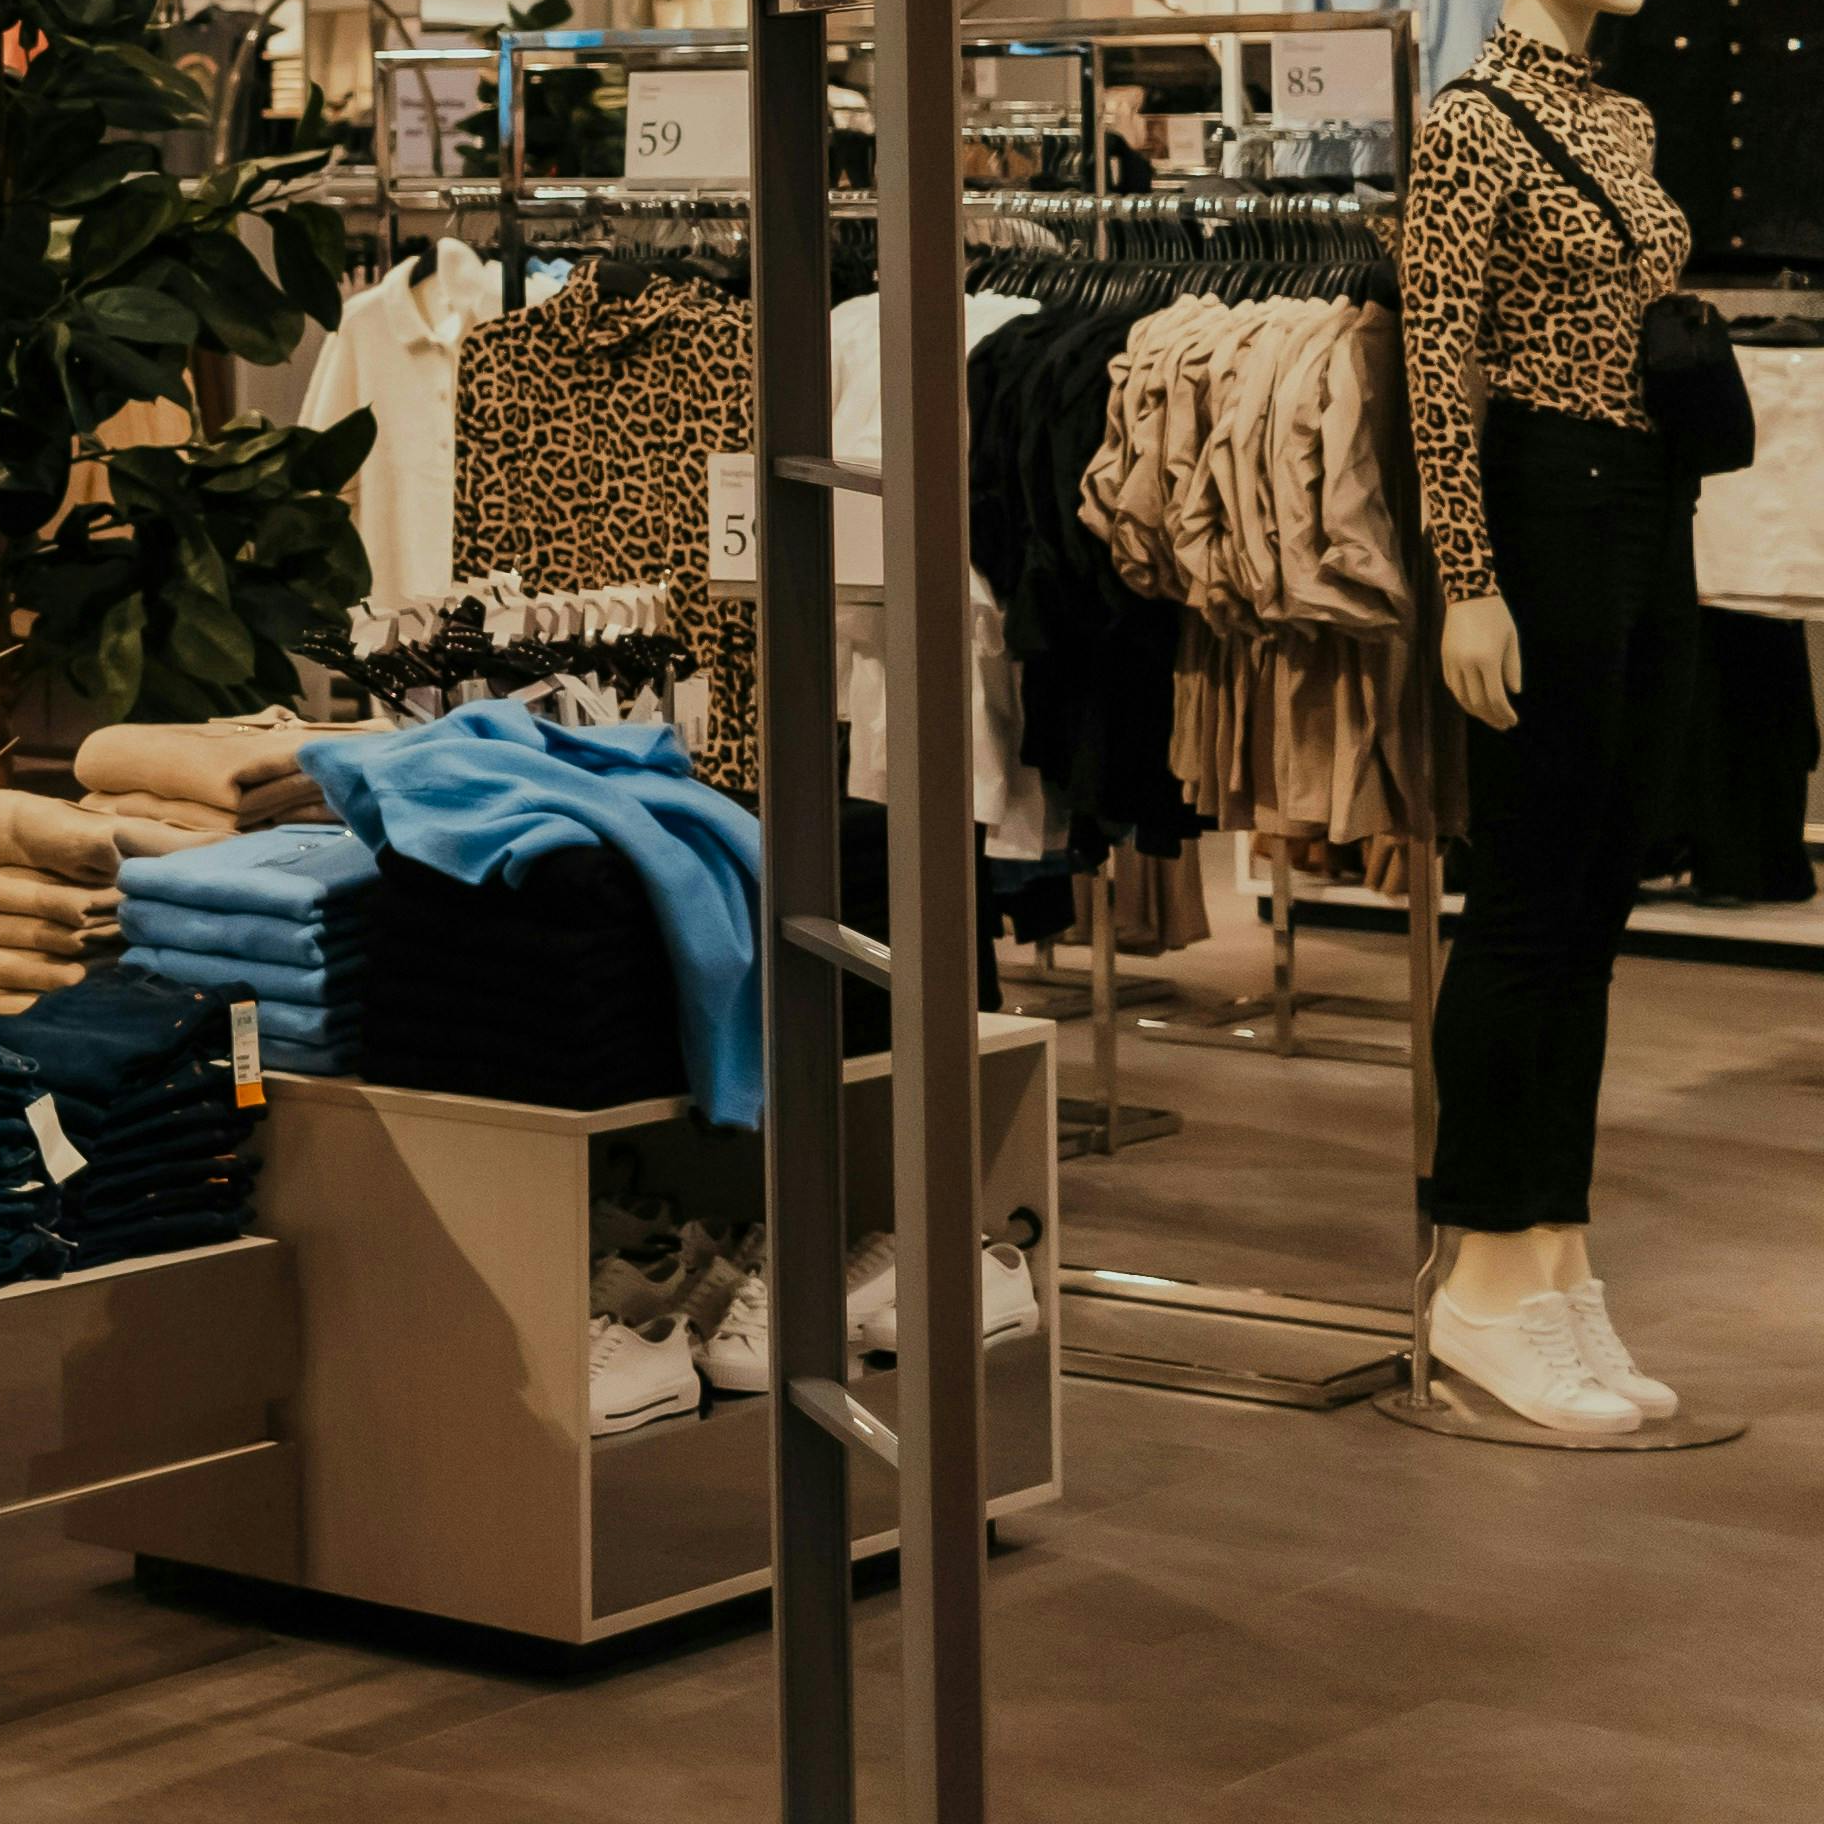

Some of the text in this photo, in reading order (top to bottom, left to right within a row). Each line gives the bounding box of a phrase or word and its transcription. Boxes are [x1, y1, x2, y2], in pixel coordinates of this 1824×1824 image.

[1287, 66, 1325, 98] 85
[638, 120, 682, 157] 59
[723, 513, 756, 556] 5
